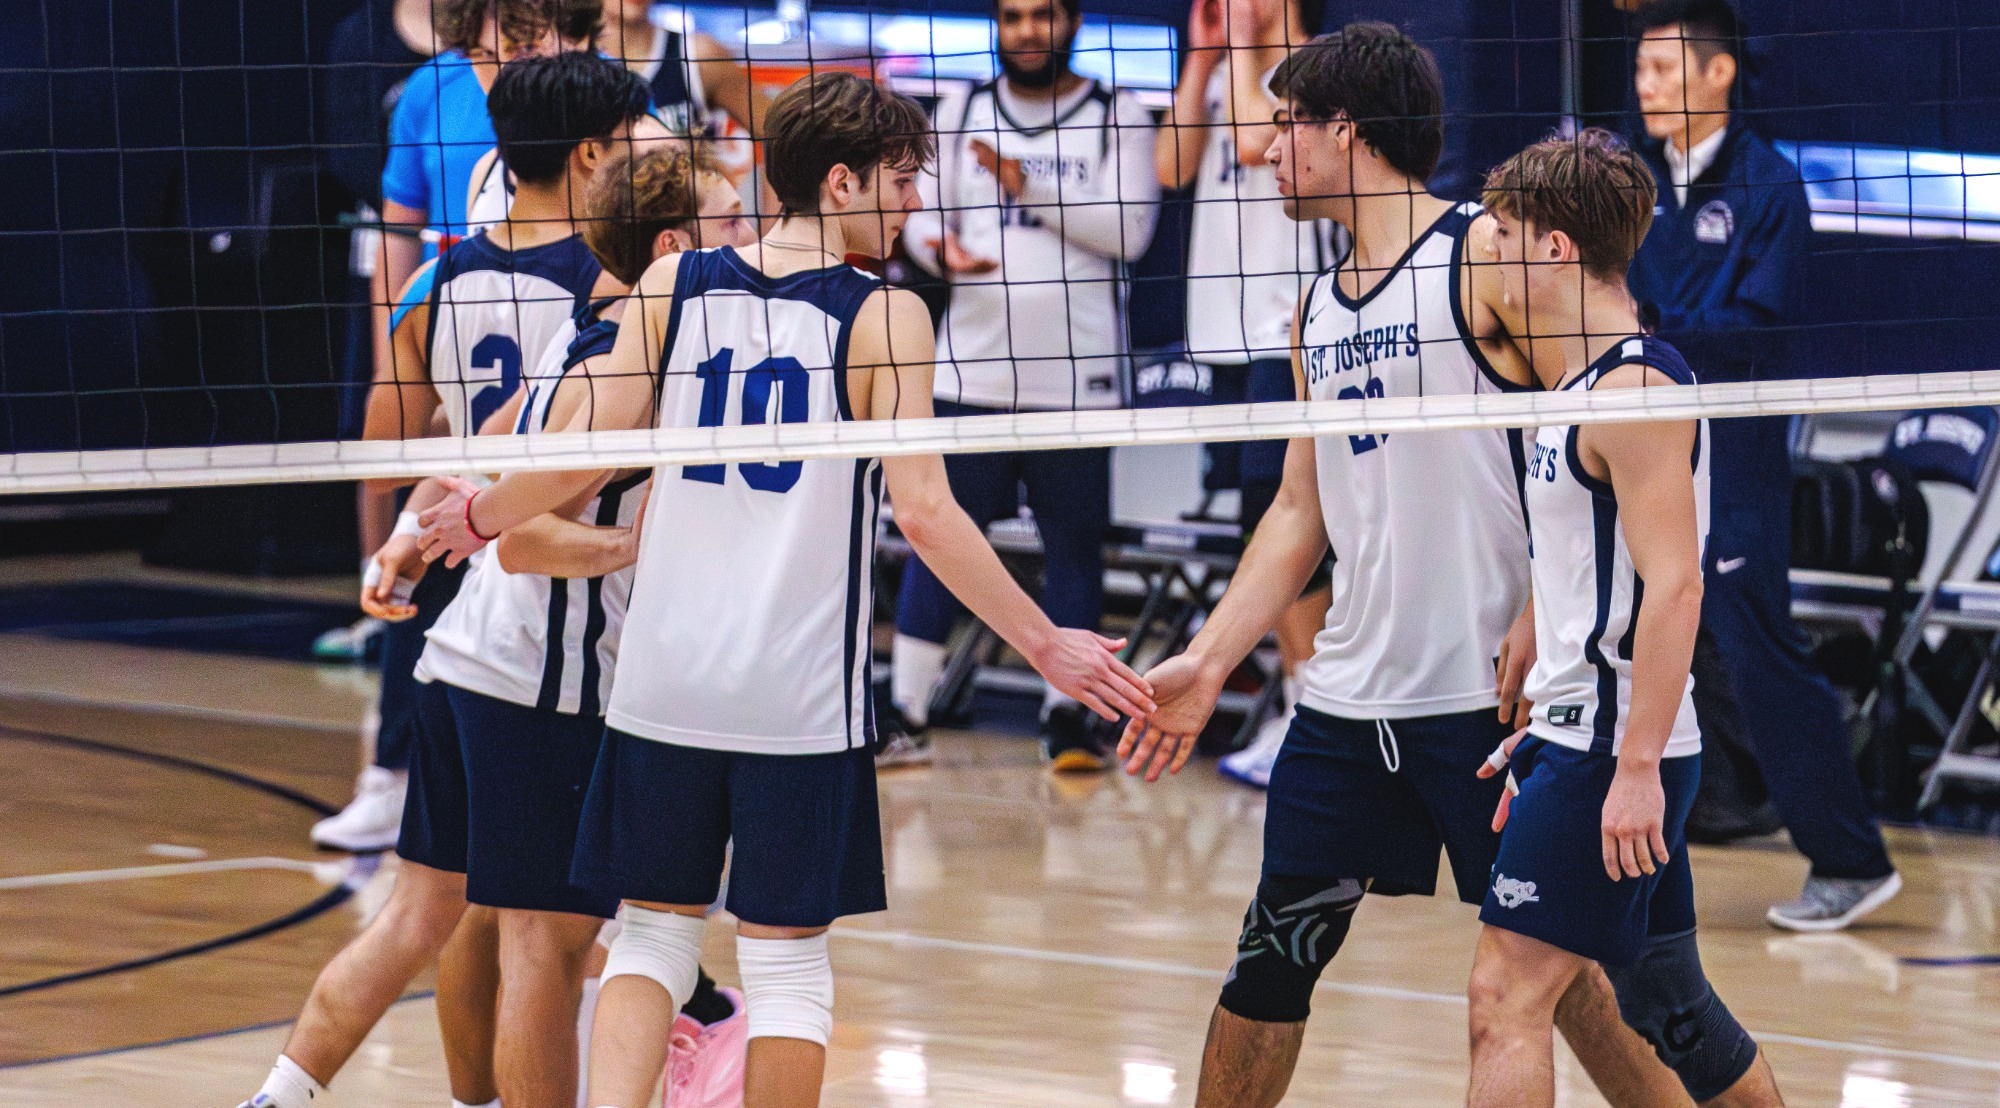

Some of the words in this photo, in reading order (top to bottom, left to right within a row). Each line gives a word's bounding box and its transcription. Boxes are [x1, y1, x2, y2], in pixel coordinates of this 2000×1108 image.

[471, 333, 522, 436] 2
[1311, 344, 1329, 385] ST.
[1335, 322, 1419, 374] JOSEPH'S
[681, 347, 810, 493] 10
